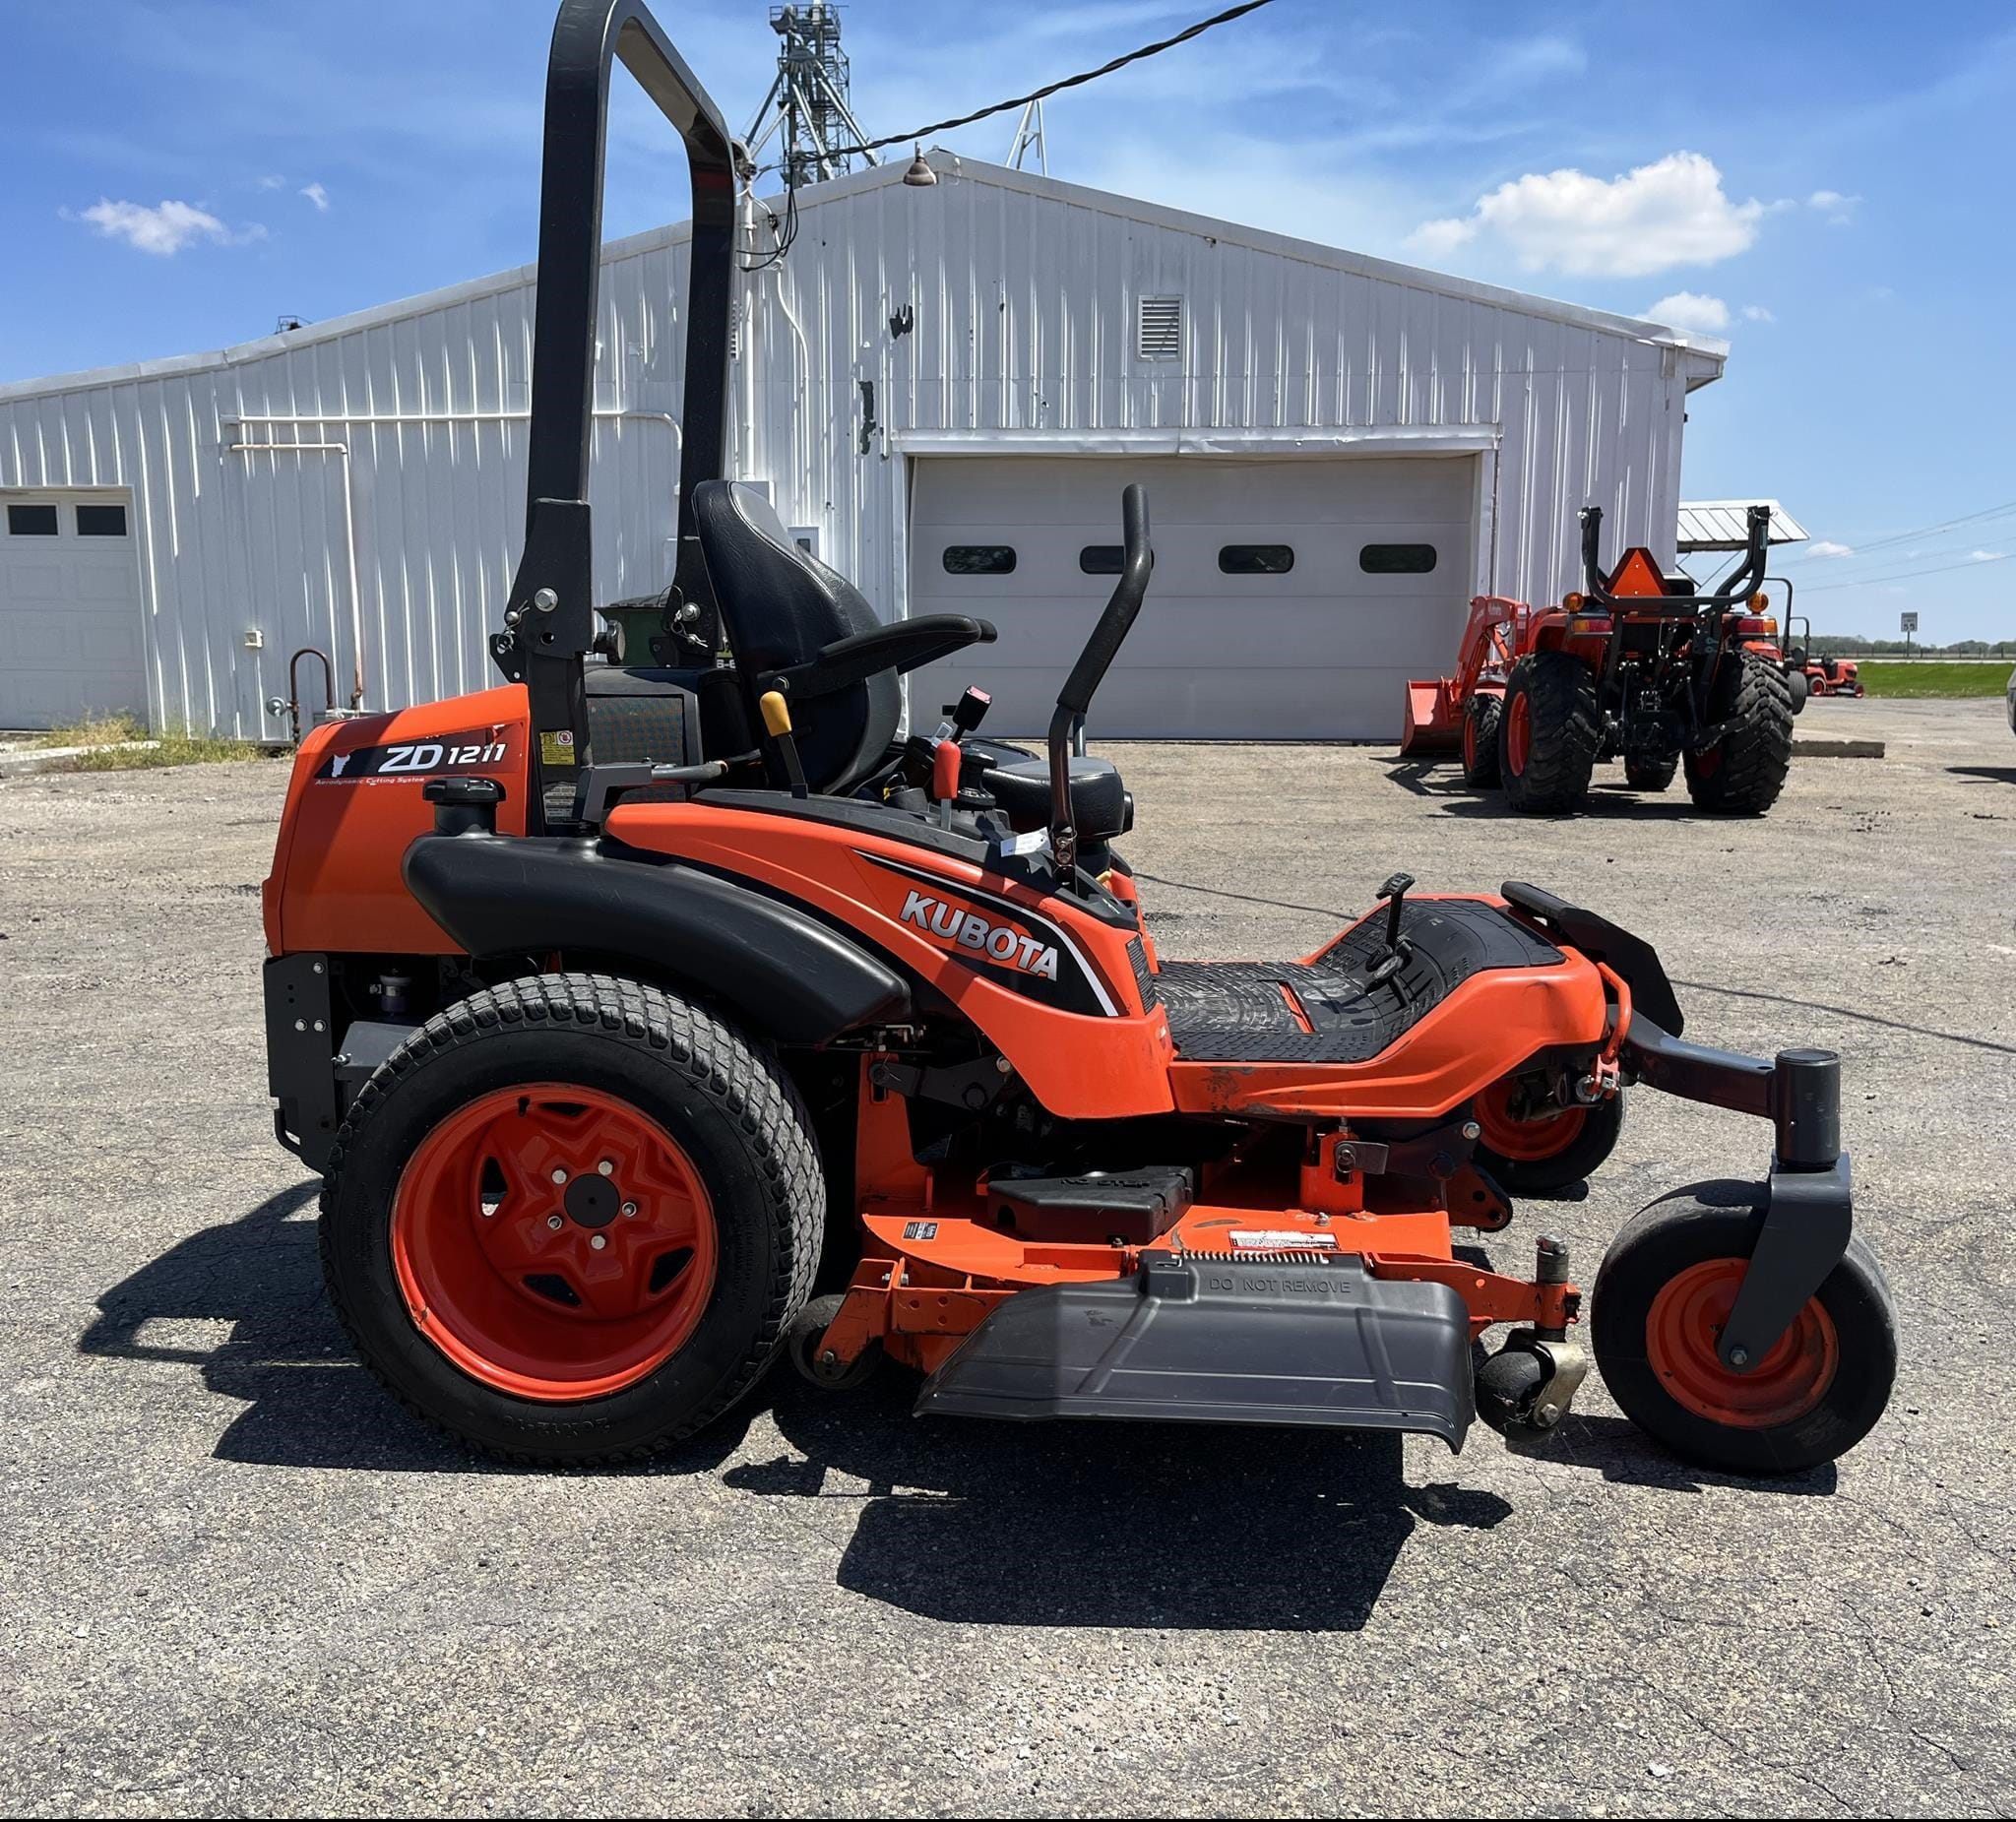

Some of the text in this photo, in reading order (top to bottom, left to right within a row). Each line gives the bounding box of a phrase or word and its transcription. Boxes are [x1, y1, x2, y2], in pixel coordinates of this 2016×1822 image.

[378, 743, 506, 773] ZD 1211
[366, 777, 395, 785] Cutting
[899, 890, 1058, 982] KUBOTA
[1209, 1279, 1351, 1293] DO NOT REMOVE
